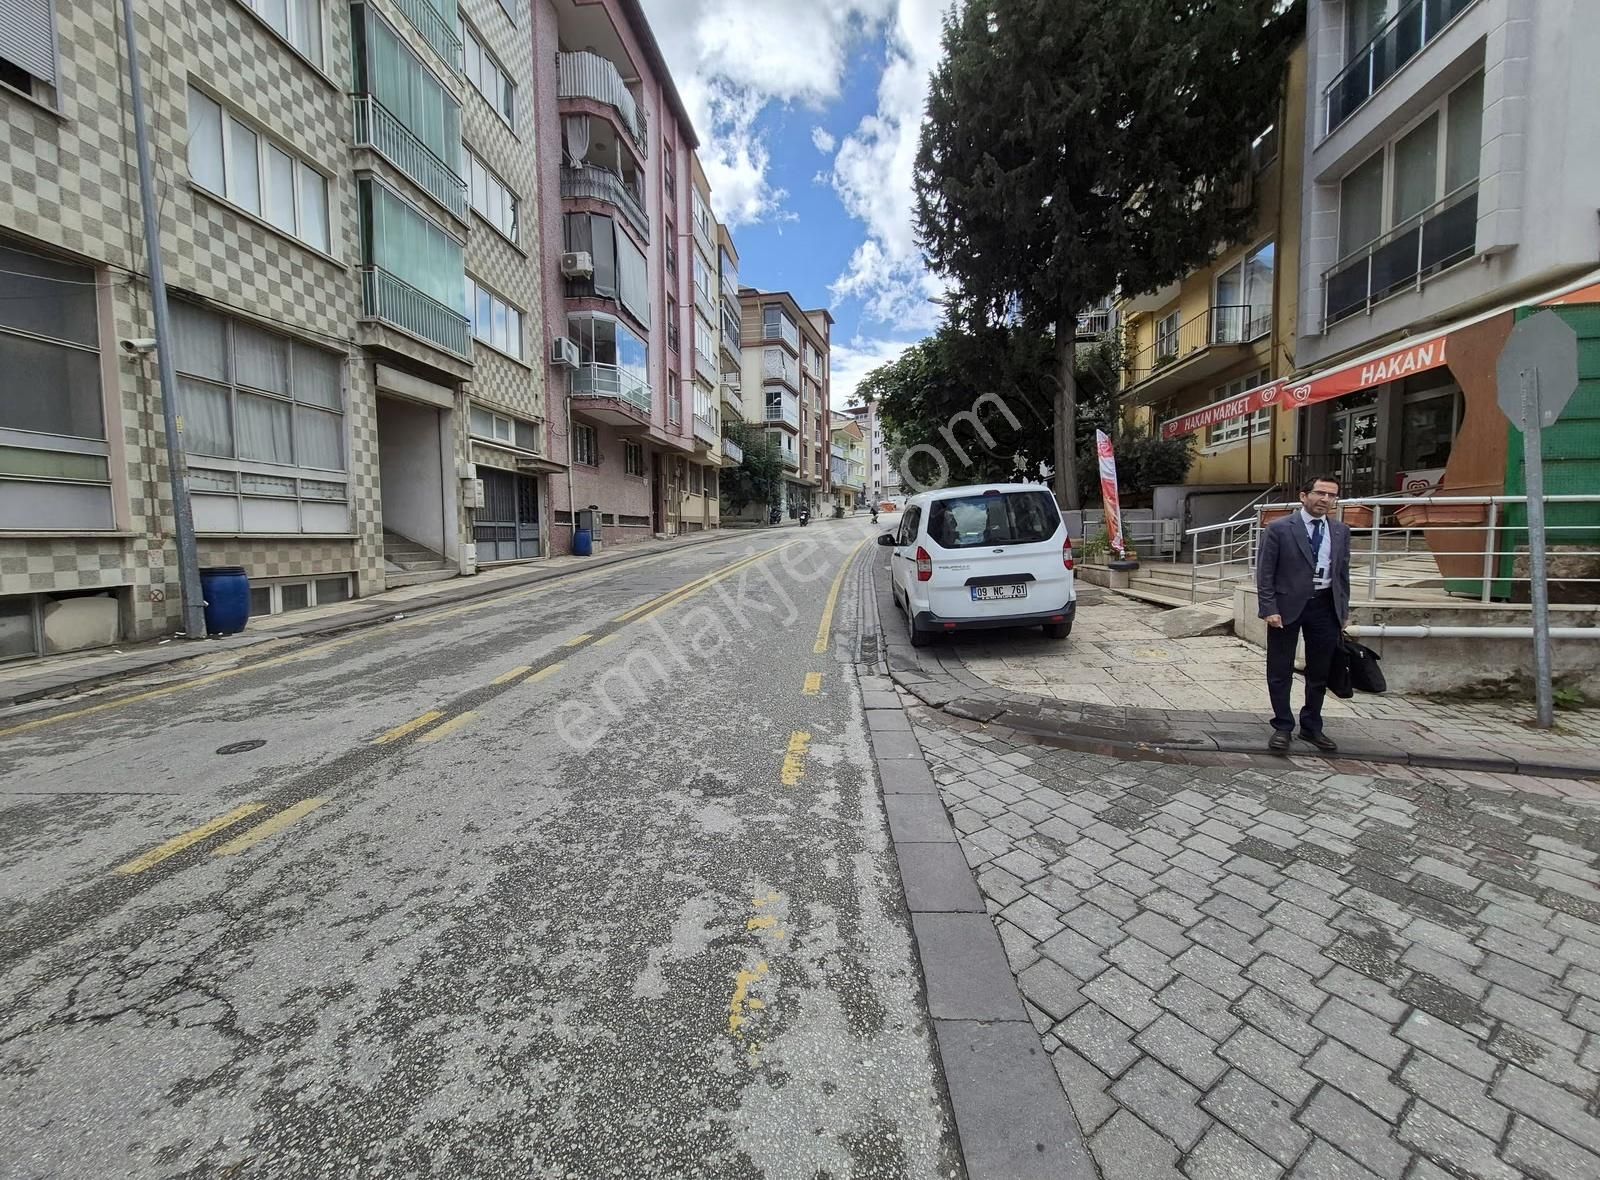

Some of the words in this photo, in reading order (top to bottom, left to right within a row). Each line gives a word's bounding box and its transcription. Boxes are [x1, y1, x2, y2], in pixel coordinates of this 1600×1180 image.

[1360, 344, 1434, 386] HAKAN
[1184, 412, 1212, 431] HAKAN
[1212, 397, 1250, 420] MARKET
[977, 588, 988, 597] 09
[993, 586, 1004, 596] NC
[1011, 585, 1026, 595] 761
